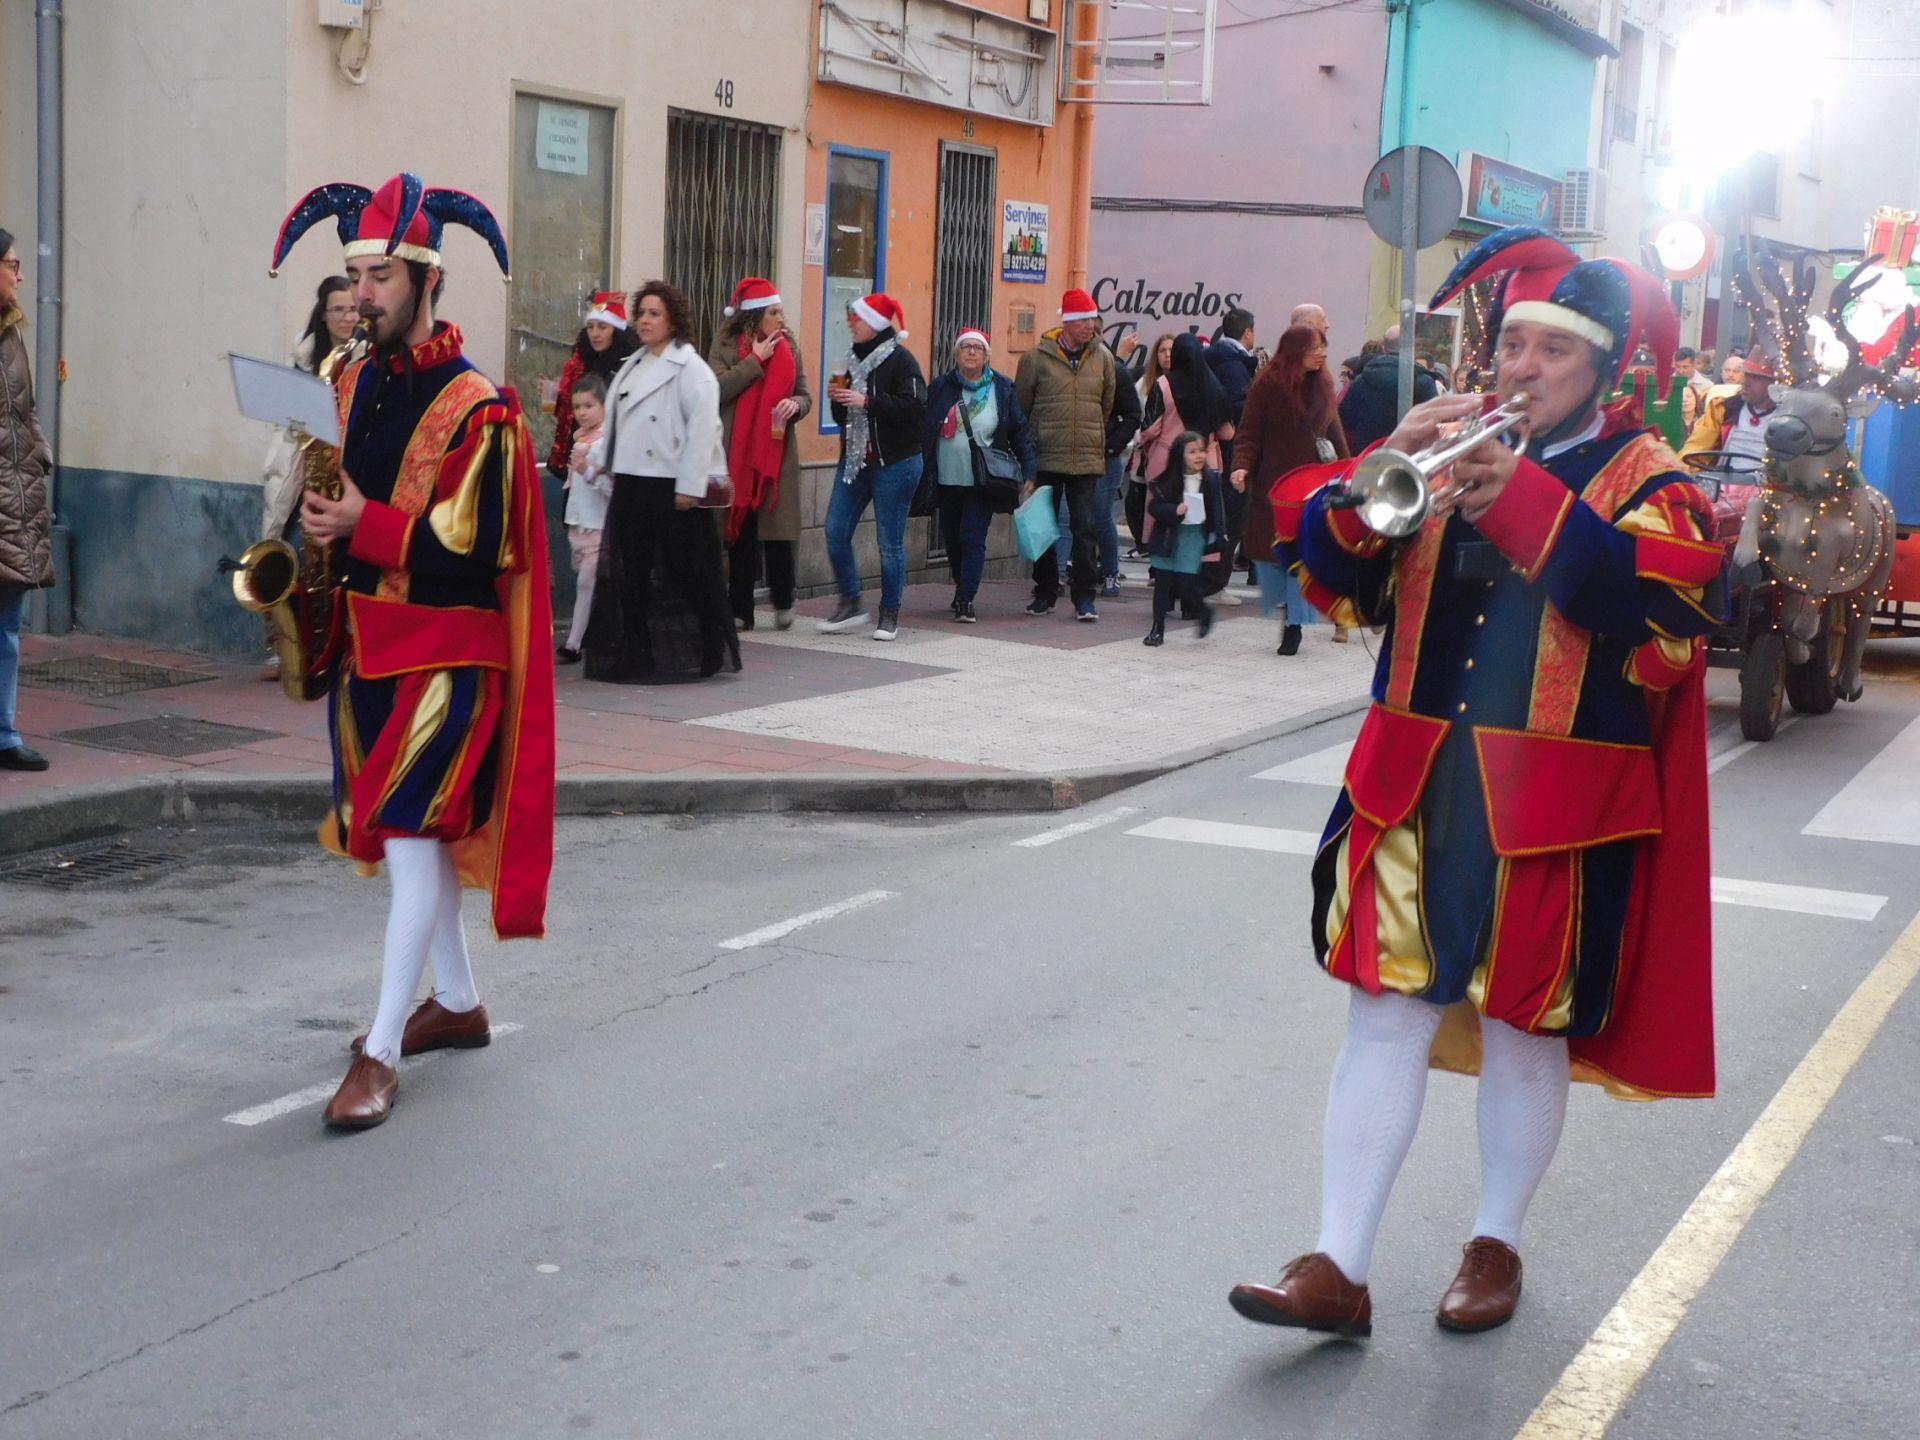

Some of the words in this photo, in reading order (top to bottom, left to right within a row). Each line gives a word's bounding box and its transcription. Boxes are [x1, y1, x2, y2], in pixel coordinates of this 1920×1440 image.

[714, 78, 734, 109] 48
[963, 119, 976, 138] 46
[1011, 234, 1042, 253] VENDE
[1091, 277, 1243, 321] Calzados
